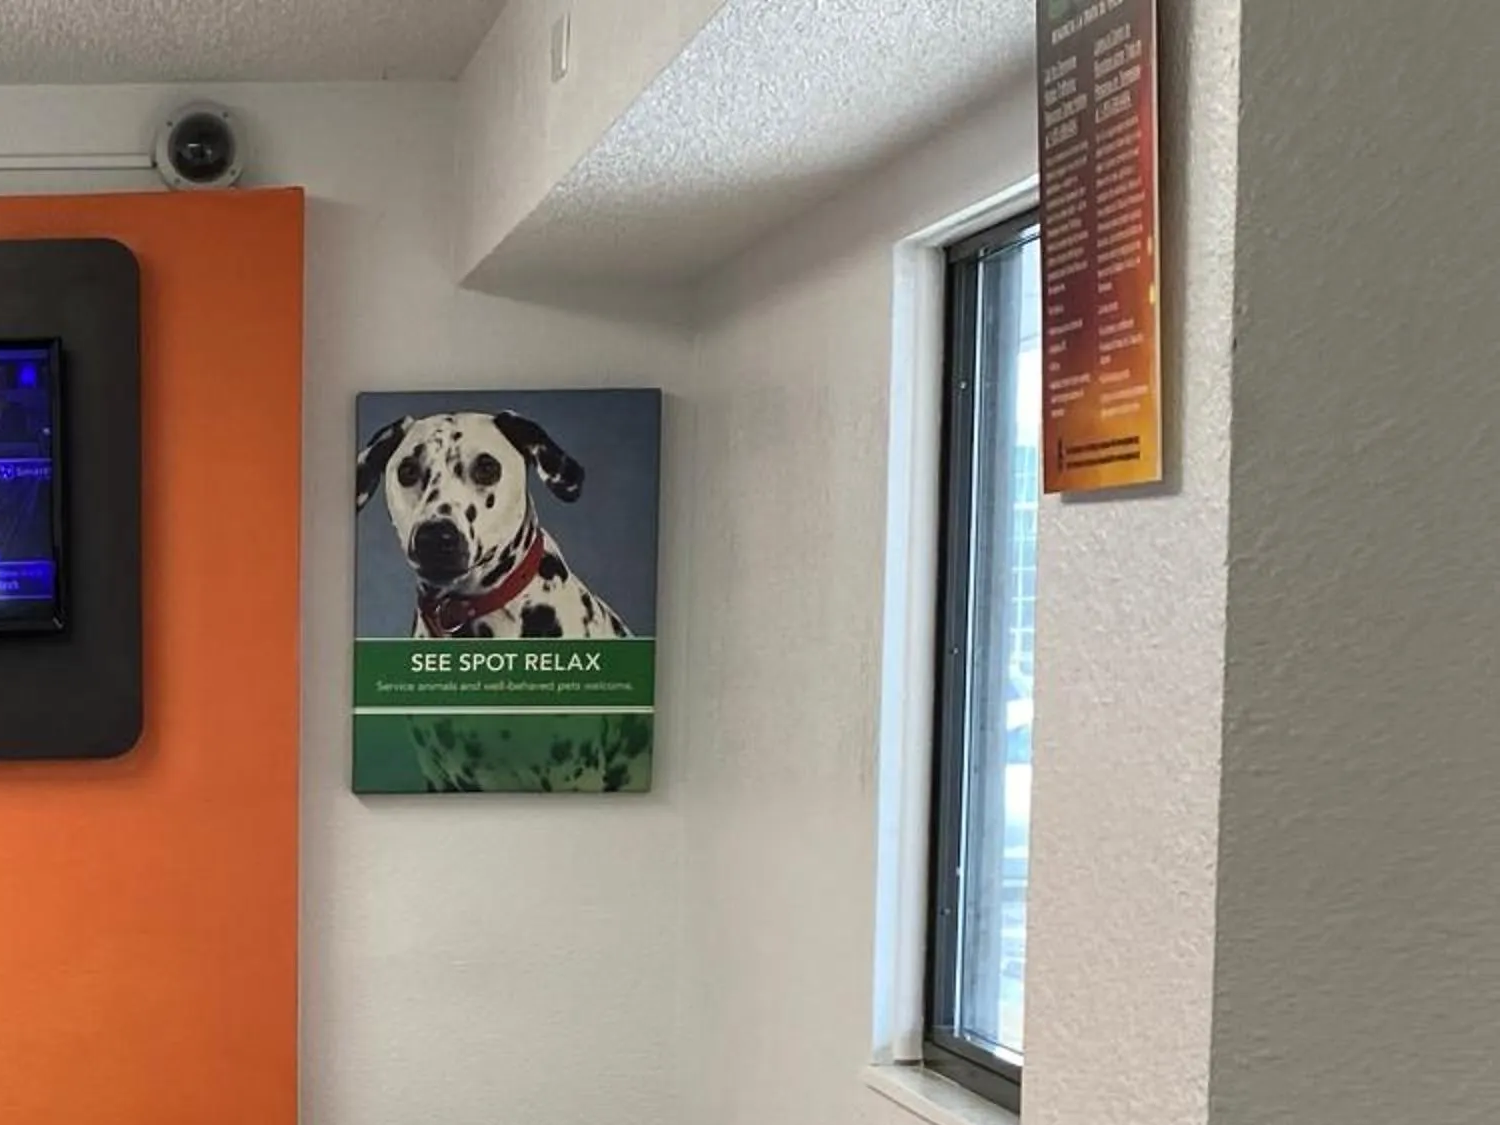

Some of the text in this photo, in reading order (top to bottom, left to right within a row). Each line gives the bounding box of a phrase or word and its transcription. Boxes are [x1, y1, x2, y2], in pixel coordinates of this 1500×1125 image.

[411, 652, 602, 672] SEE SPOT RELAX
[377, 680, 415, 692] Service
[417, 680, 457, 692] animals
[460, 680, 482, 692] and
[484, 680, 555, 692] well-behaved
[557, 681, 581, 694] pets
